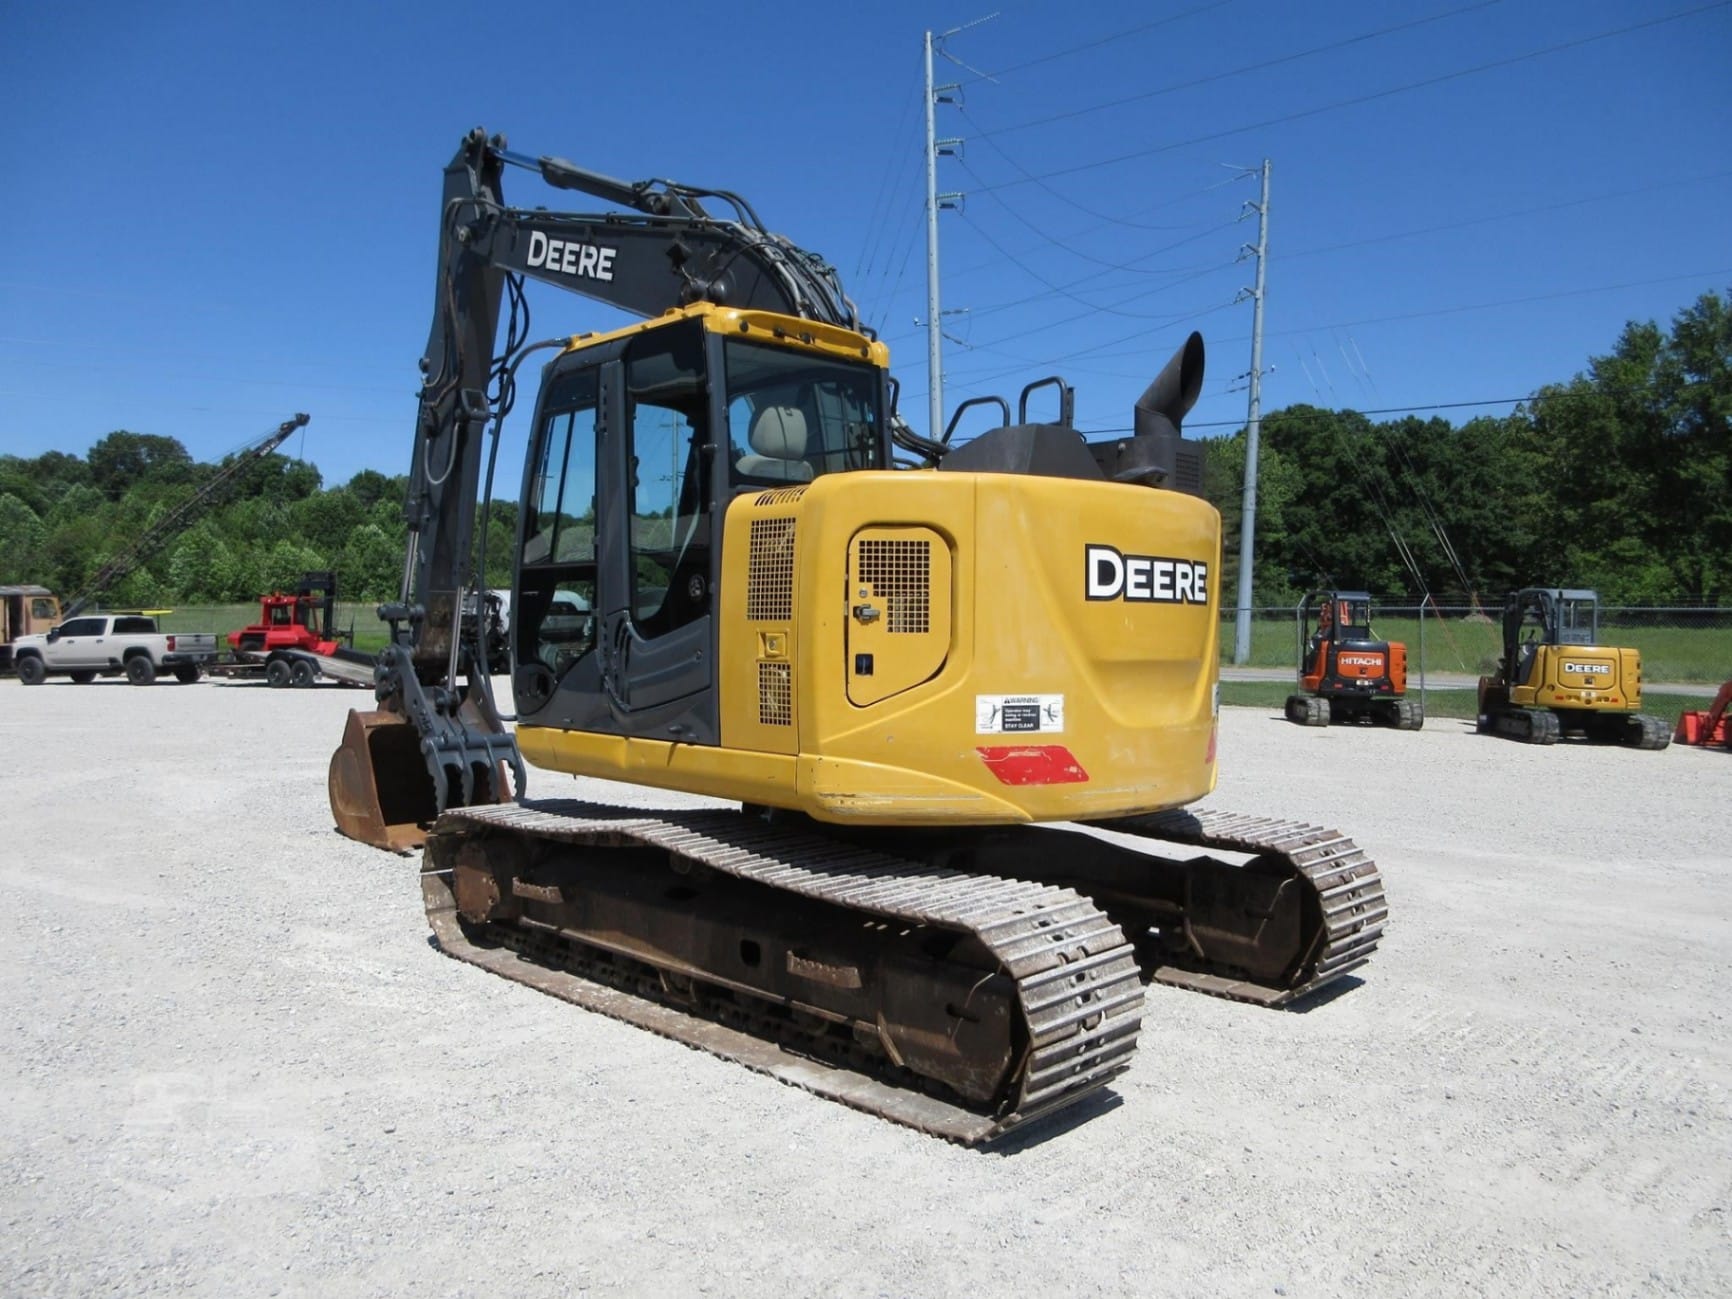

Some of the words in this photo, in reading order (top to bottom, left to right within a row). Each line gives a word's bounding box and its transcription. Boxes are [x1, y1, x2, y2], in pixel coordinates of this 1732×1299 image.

[527, 230, 617, 281] DEERE
[1087, 547, 1207, 602] DEERE
[1341, 657, 1383, 666] HITACHI
[1565, 662, 1609, 674] DEERE
